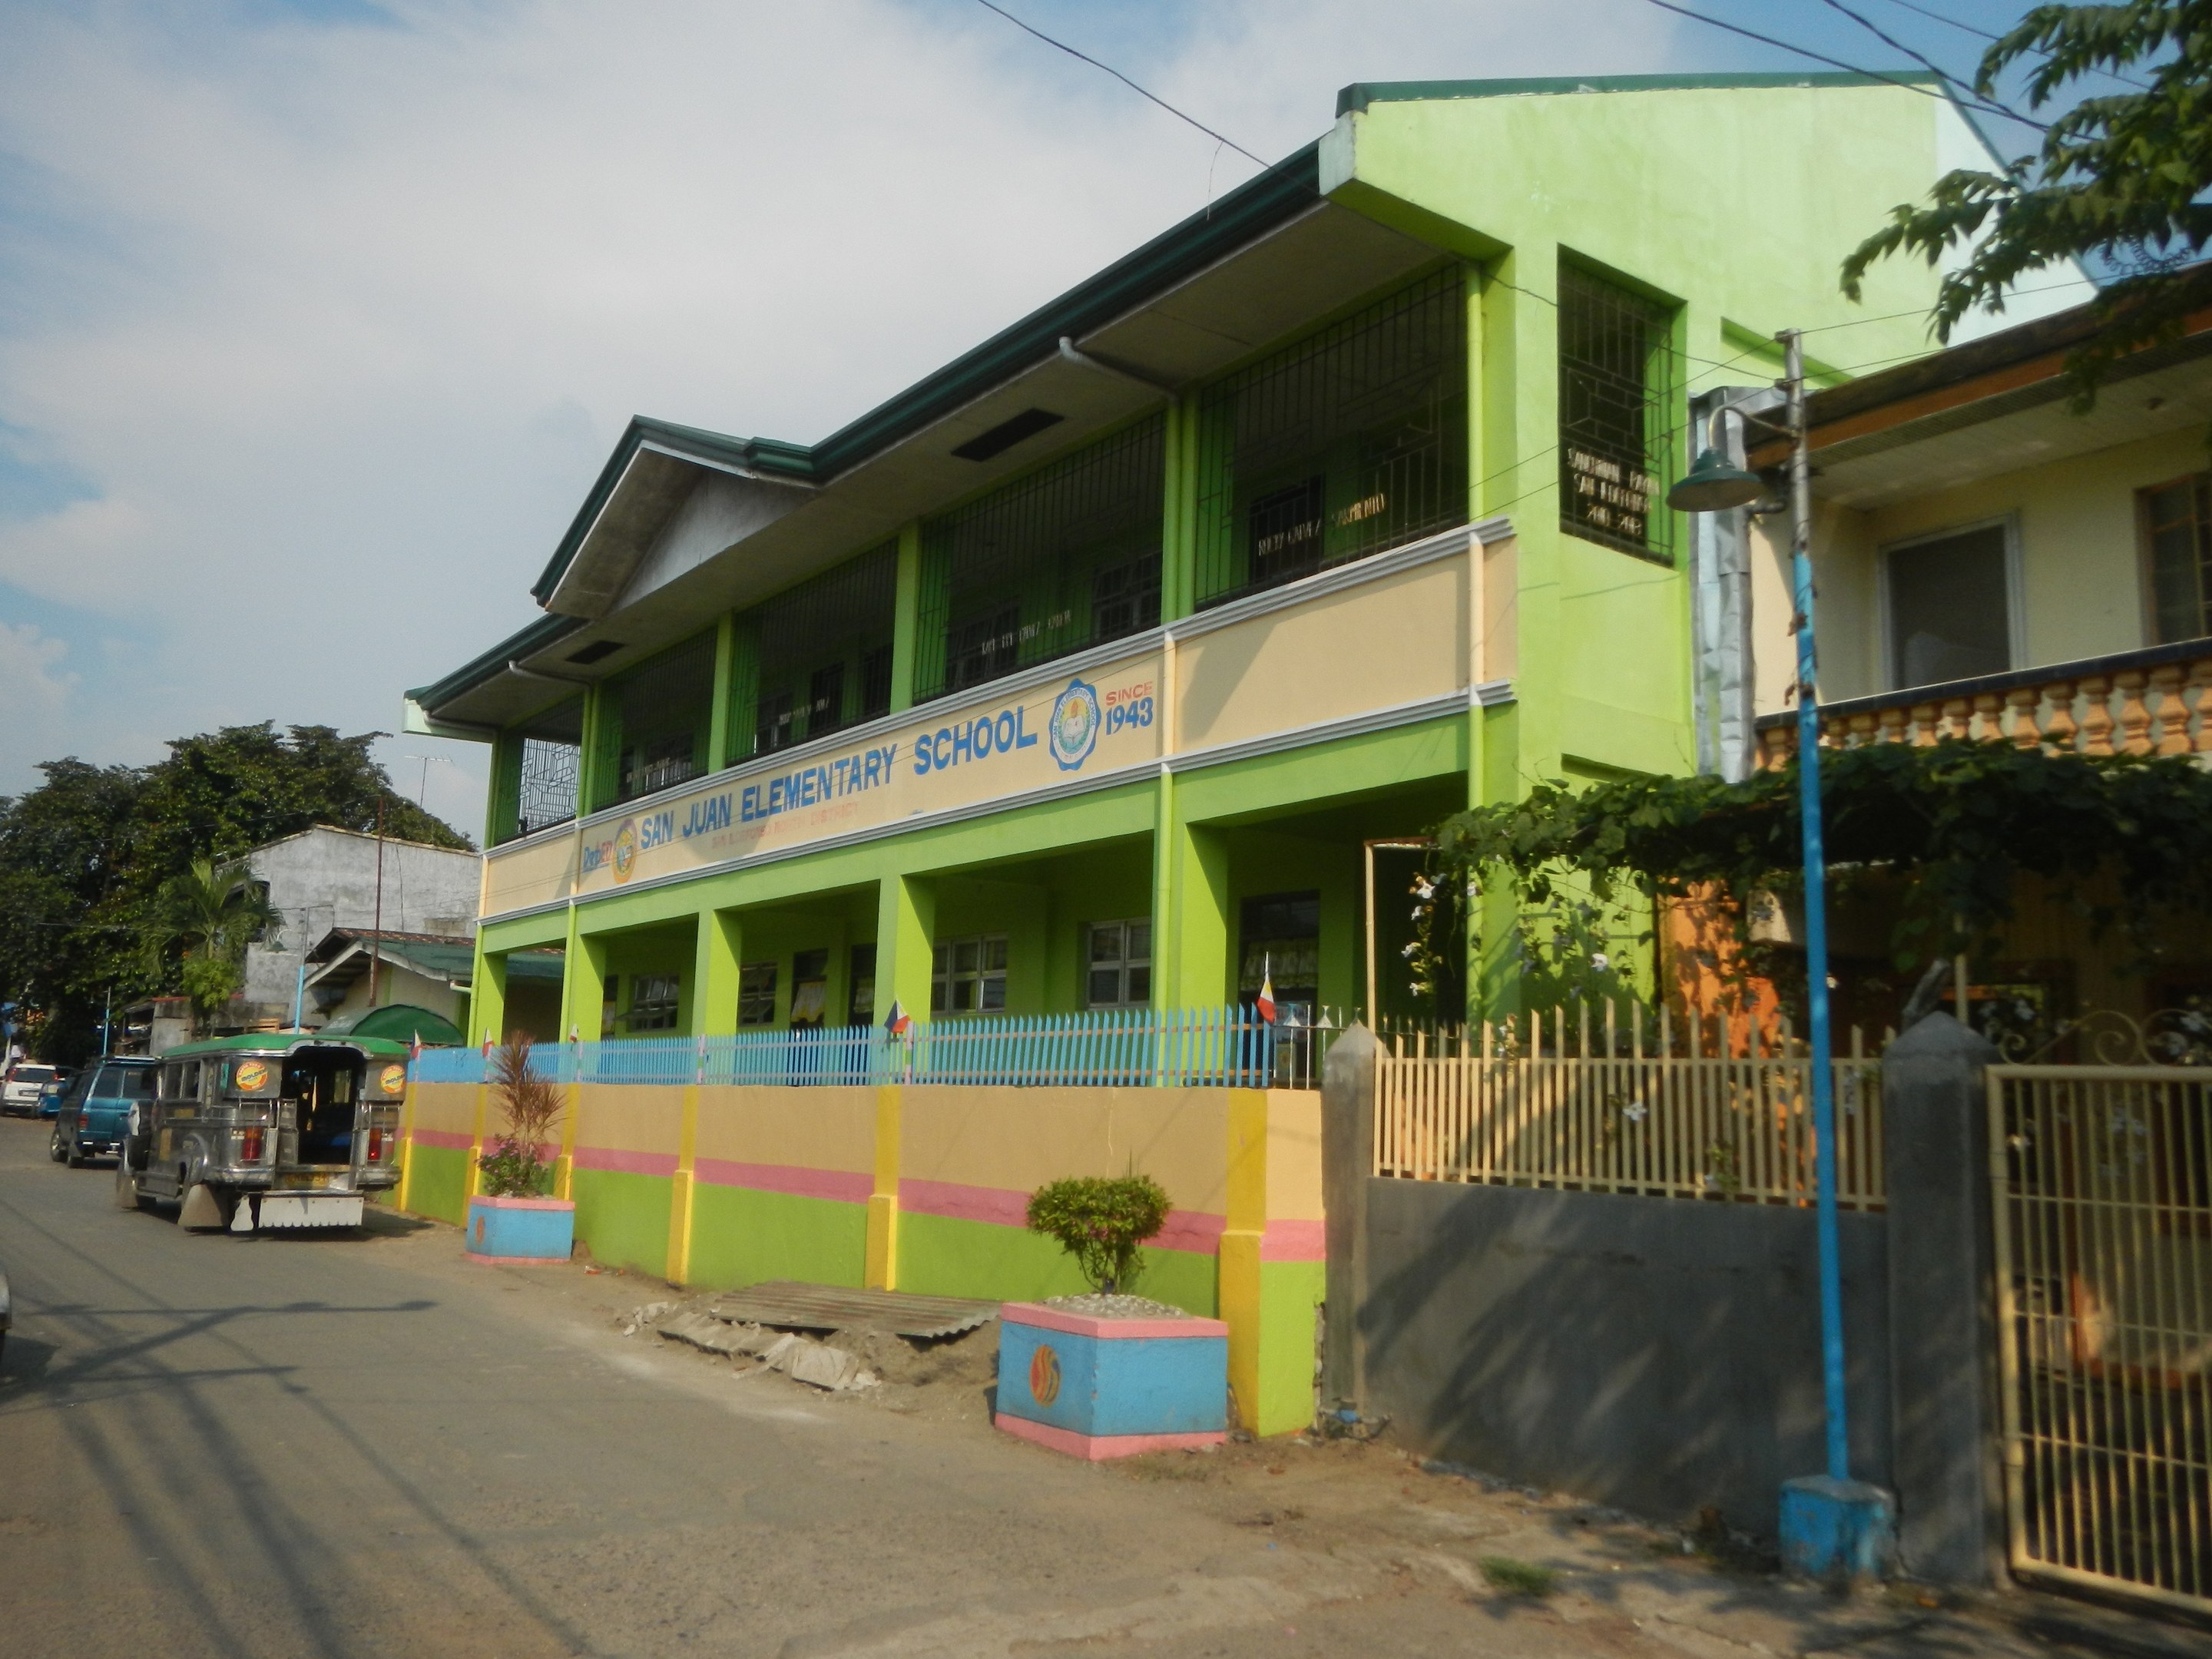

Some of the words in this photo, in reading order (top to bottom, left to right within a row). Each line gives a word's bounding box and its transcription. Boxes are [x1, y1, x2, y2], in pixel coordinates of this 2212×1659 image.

[1105, 681, 1153, 706] SINCE
[1106, 697, 1154, 736] 1943
[641, 810, 674, 849] SAN
[683, 793, 732, 837] JUAN
[741, 743, 897, 823] ELEMENTARY
[913, 706, 1038, 775] SCHOOL
